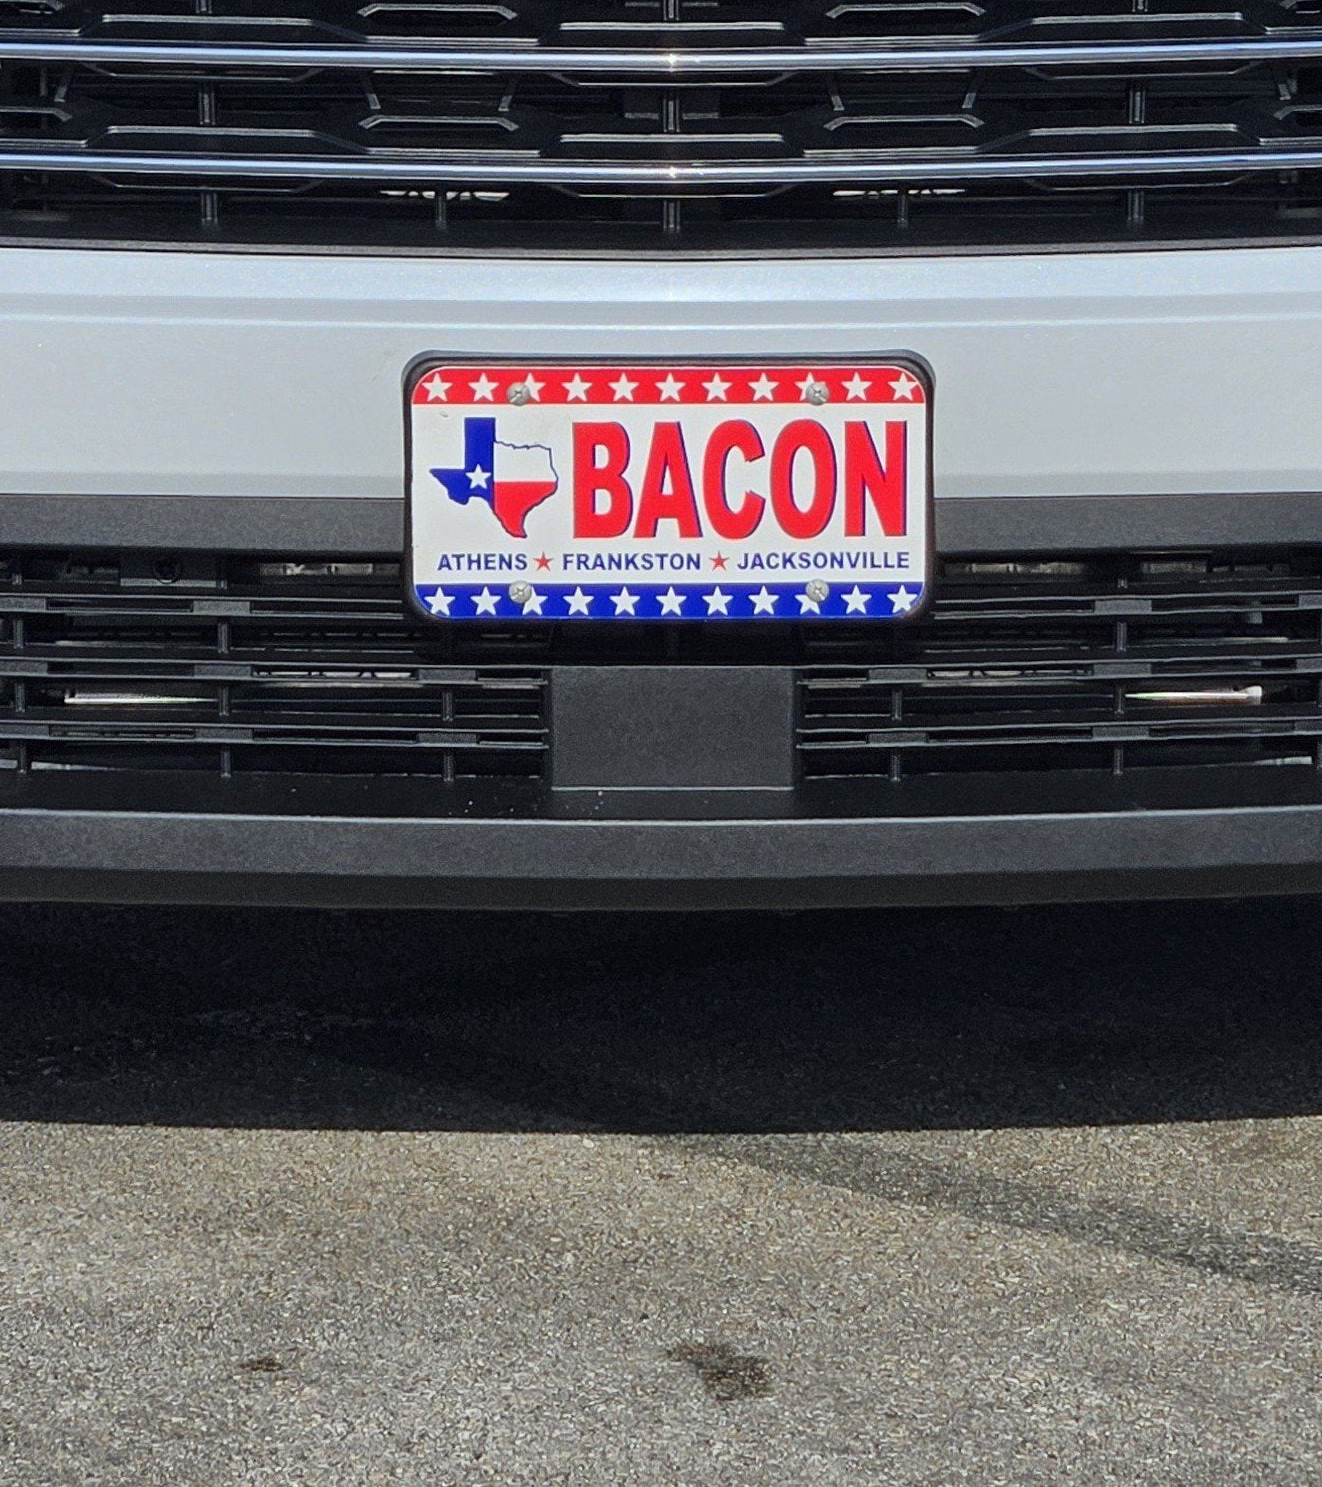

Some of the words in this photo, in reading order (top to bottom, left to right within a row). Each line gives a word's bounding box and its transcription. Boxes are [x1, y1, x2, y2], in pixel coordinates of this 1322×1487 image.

[572, 418, 908, 541] BACON
[437, 552, 528, 572] ATHENS
[562, 552, 701, 572] FRANKSTON
[737, 551, 910, 571] JACKSONVILLE
